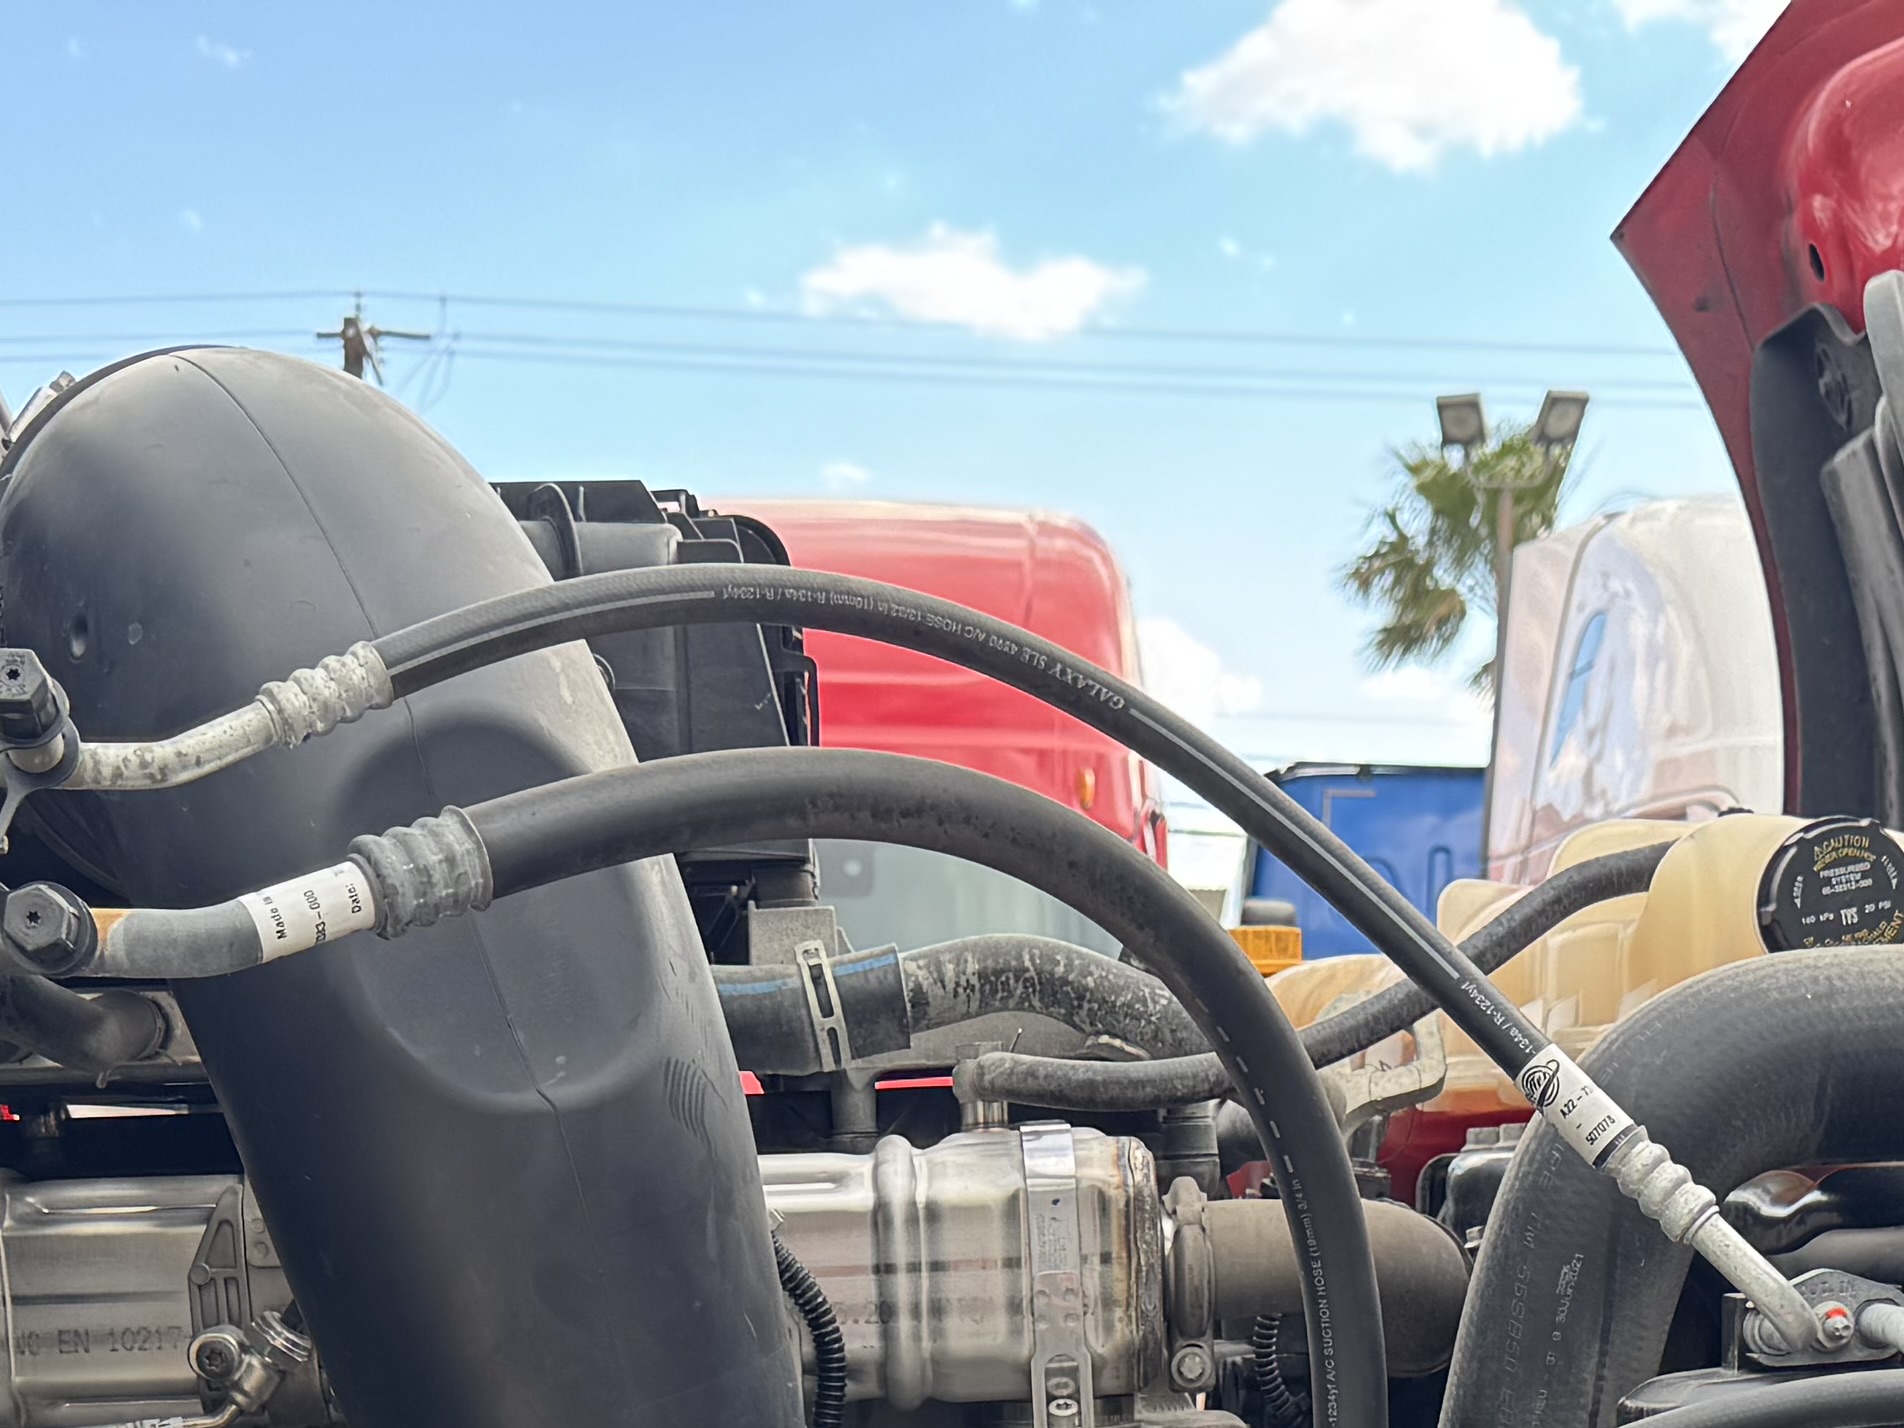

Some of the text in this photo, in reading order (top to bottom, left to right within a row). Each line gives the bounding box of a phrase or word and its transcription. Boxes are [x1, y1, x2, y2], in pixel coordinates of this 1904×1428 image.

[926, 613, 963, 634] HOSE
[1048, 663, 1127, 711] GALAXY
[1509, 1026, 1537, 1055] -134a
[1312, 1259, 1327, 1296] HOSE
[1319, 1298, 1335, 1356] SUCTION
